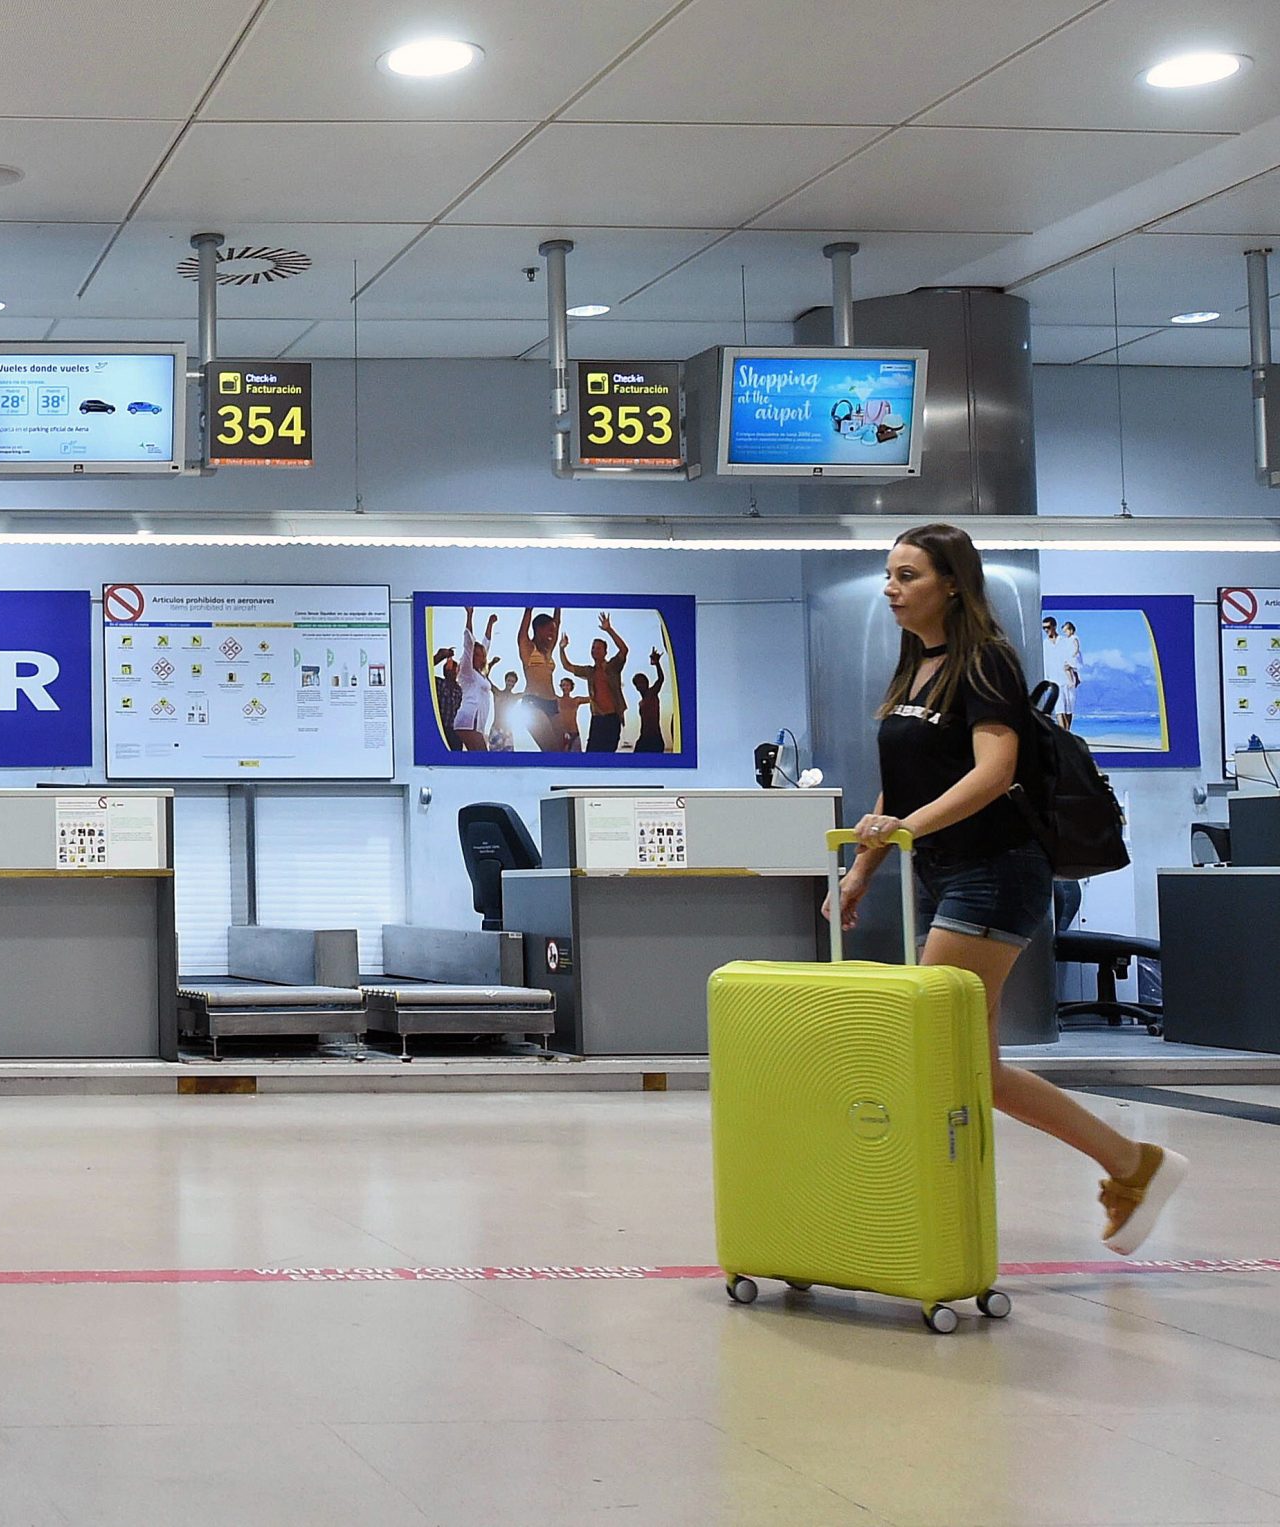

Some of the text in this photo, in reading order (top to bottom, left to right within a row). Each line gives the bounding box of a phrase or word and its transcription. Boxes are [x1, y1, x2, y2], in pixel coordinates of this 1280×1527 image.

[60, 365, 90, 373] vueles
[246, 373, 277, 383] Check-in
[613, 374, 644, 383] Check-in
[739, 365, 819, 394] Shopping
[246, 384, 302, 394] Facturación
[613, 385, 669, 394] Facturación
[738, 391, 750, 404] at
[755, 400, 812, 426] airport
[217, 405, 306, 446] 354
[587, 405, 672, 445] 353
[186, 596, 225, 605] prohibidos
[253, 1267, 323, 1275] WAIT
